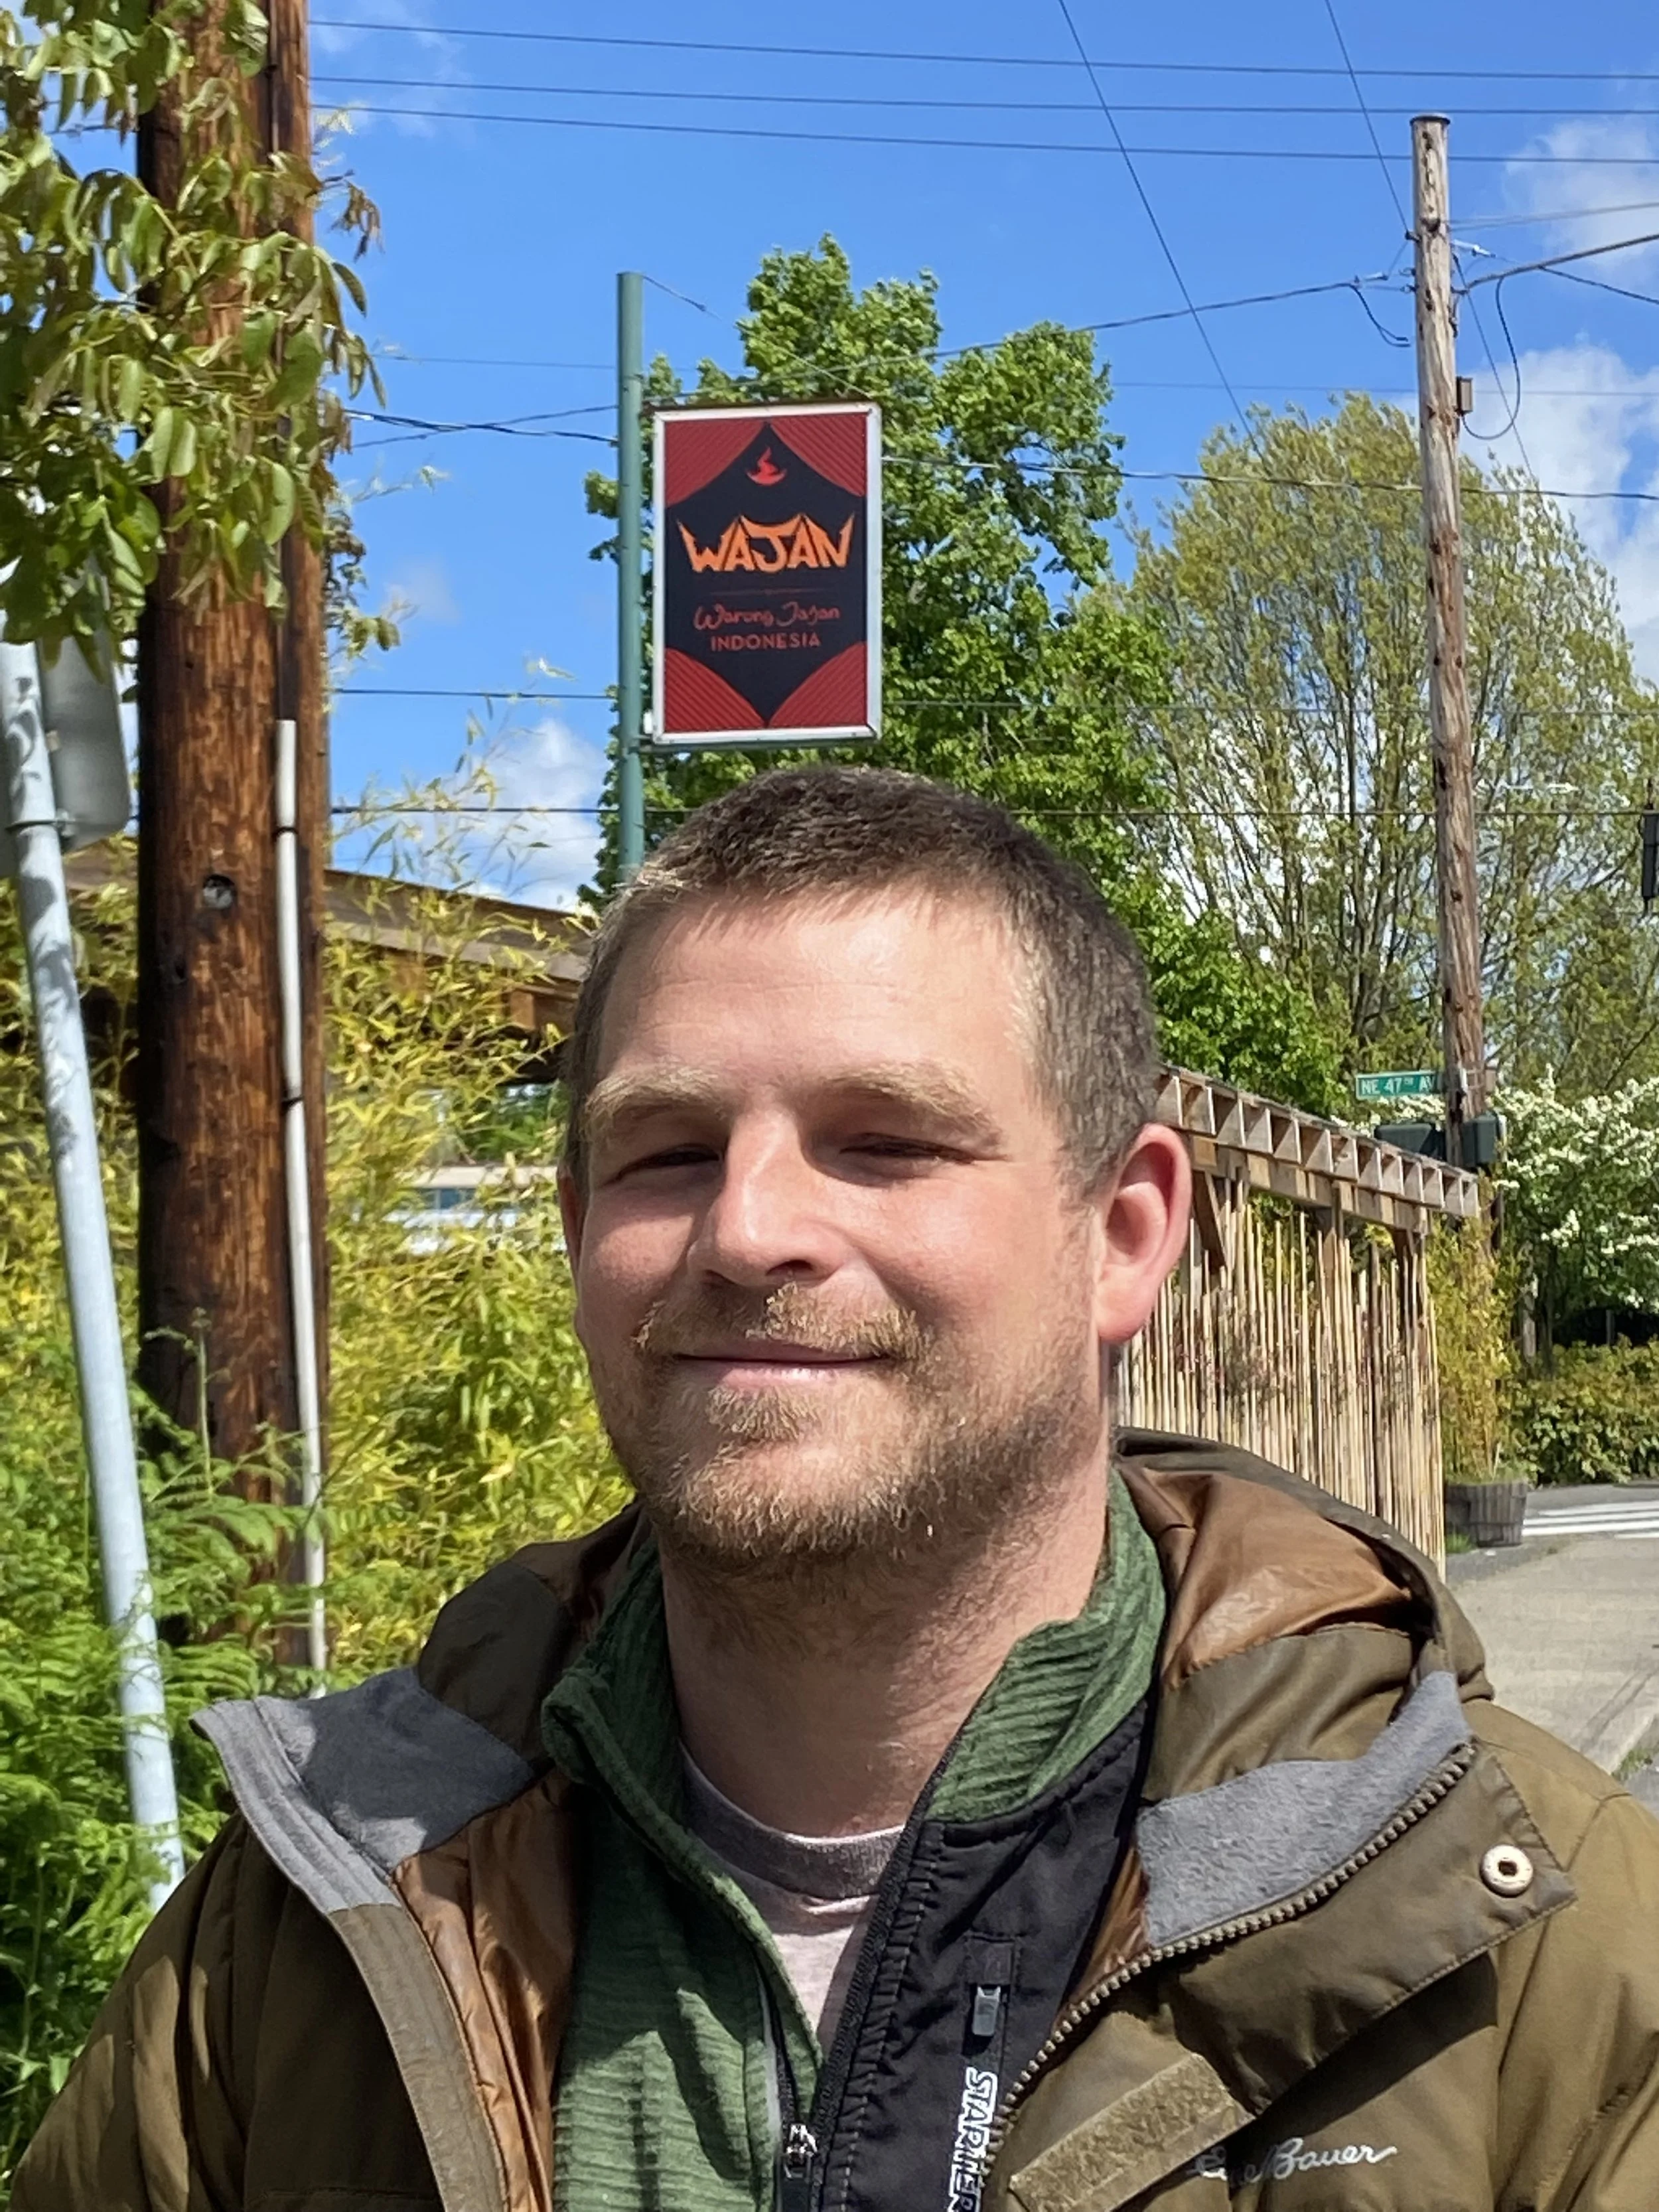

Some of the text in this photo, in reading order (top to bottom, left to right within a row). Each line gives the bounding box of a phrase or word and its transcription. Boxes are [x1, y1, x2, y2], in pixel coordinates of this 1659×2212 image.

[676, 513, 855, 573] WAJAN
[776, 602, 839, 627] Jajan
[711, 632, 821, 652] INDONESIA
[1362, 1079, 1380, 1094] NE
[1271, 2136, 1398, 2180] Bauer
